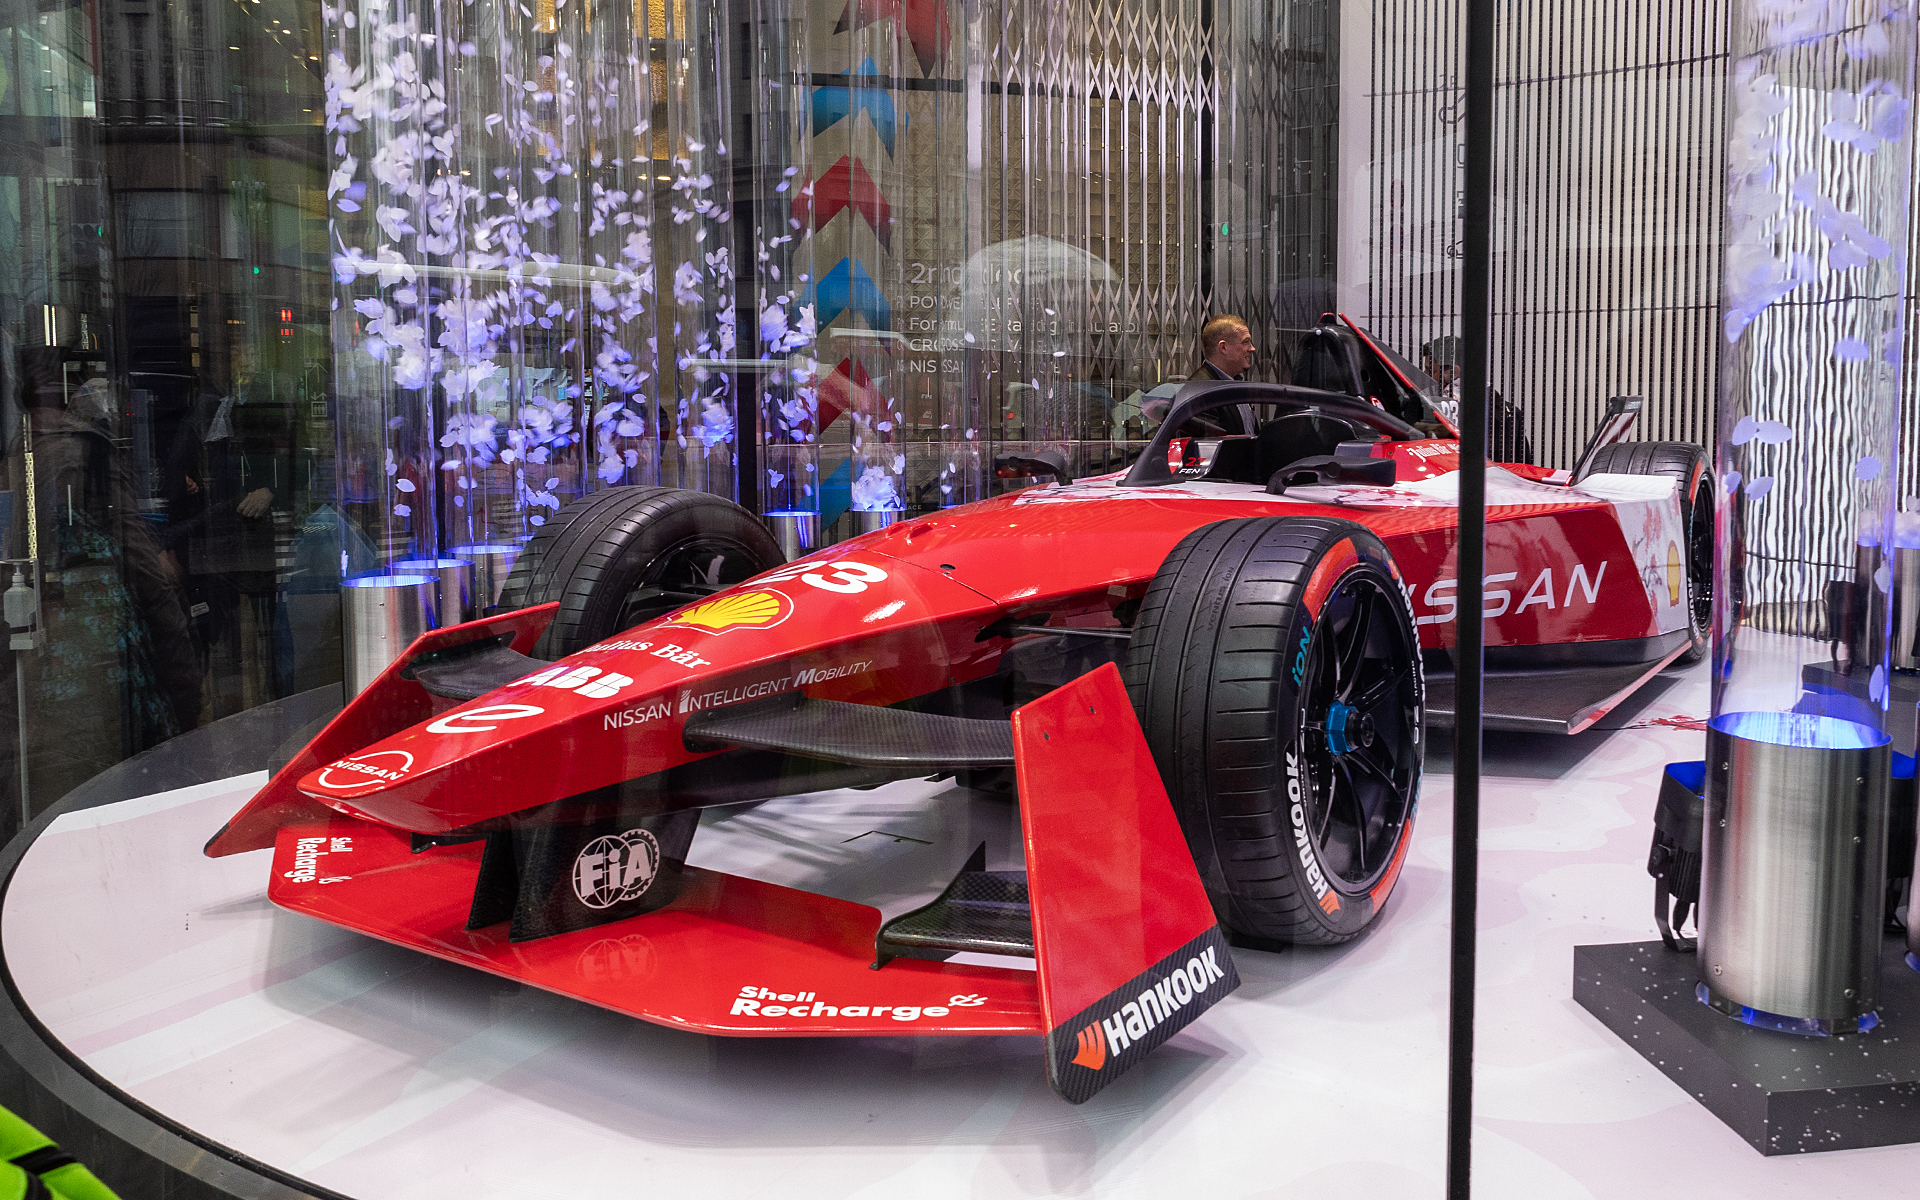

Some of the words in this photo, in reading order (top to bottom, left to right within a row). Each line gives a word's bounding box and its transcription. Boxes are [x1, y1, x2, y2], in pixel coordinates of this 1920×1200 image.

[1402, 560, 1608, 625] SSAN
[650, 643, 711, 668] Bär
[507, 665, 634, 699] ABB
[603, 702, 672, 731] NISSAN
[678, 676, 791, 714] INTELLIGENT
[793, 660, 872, 688] MOBILITY
[333, 759, 405, 781] NISSAN
[330, 837, 353, 853] Shell
[284, 837, 329, 883] Recharge
[739, 985, 816, 1003] Shell
[729, 999, 950, 1022] Recharge
